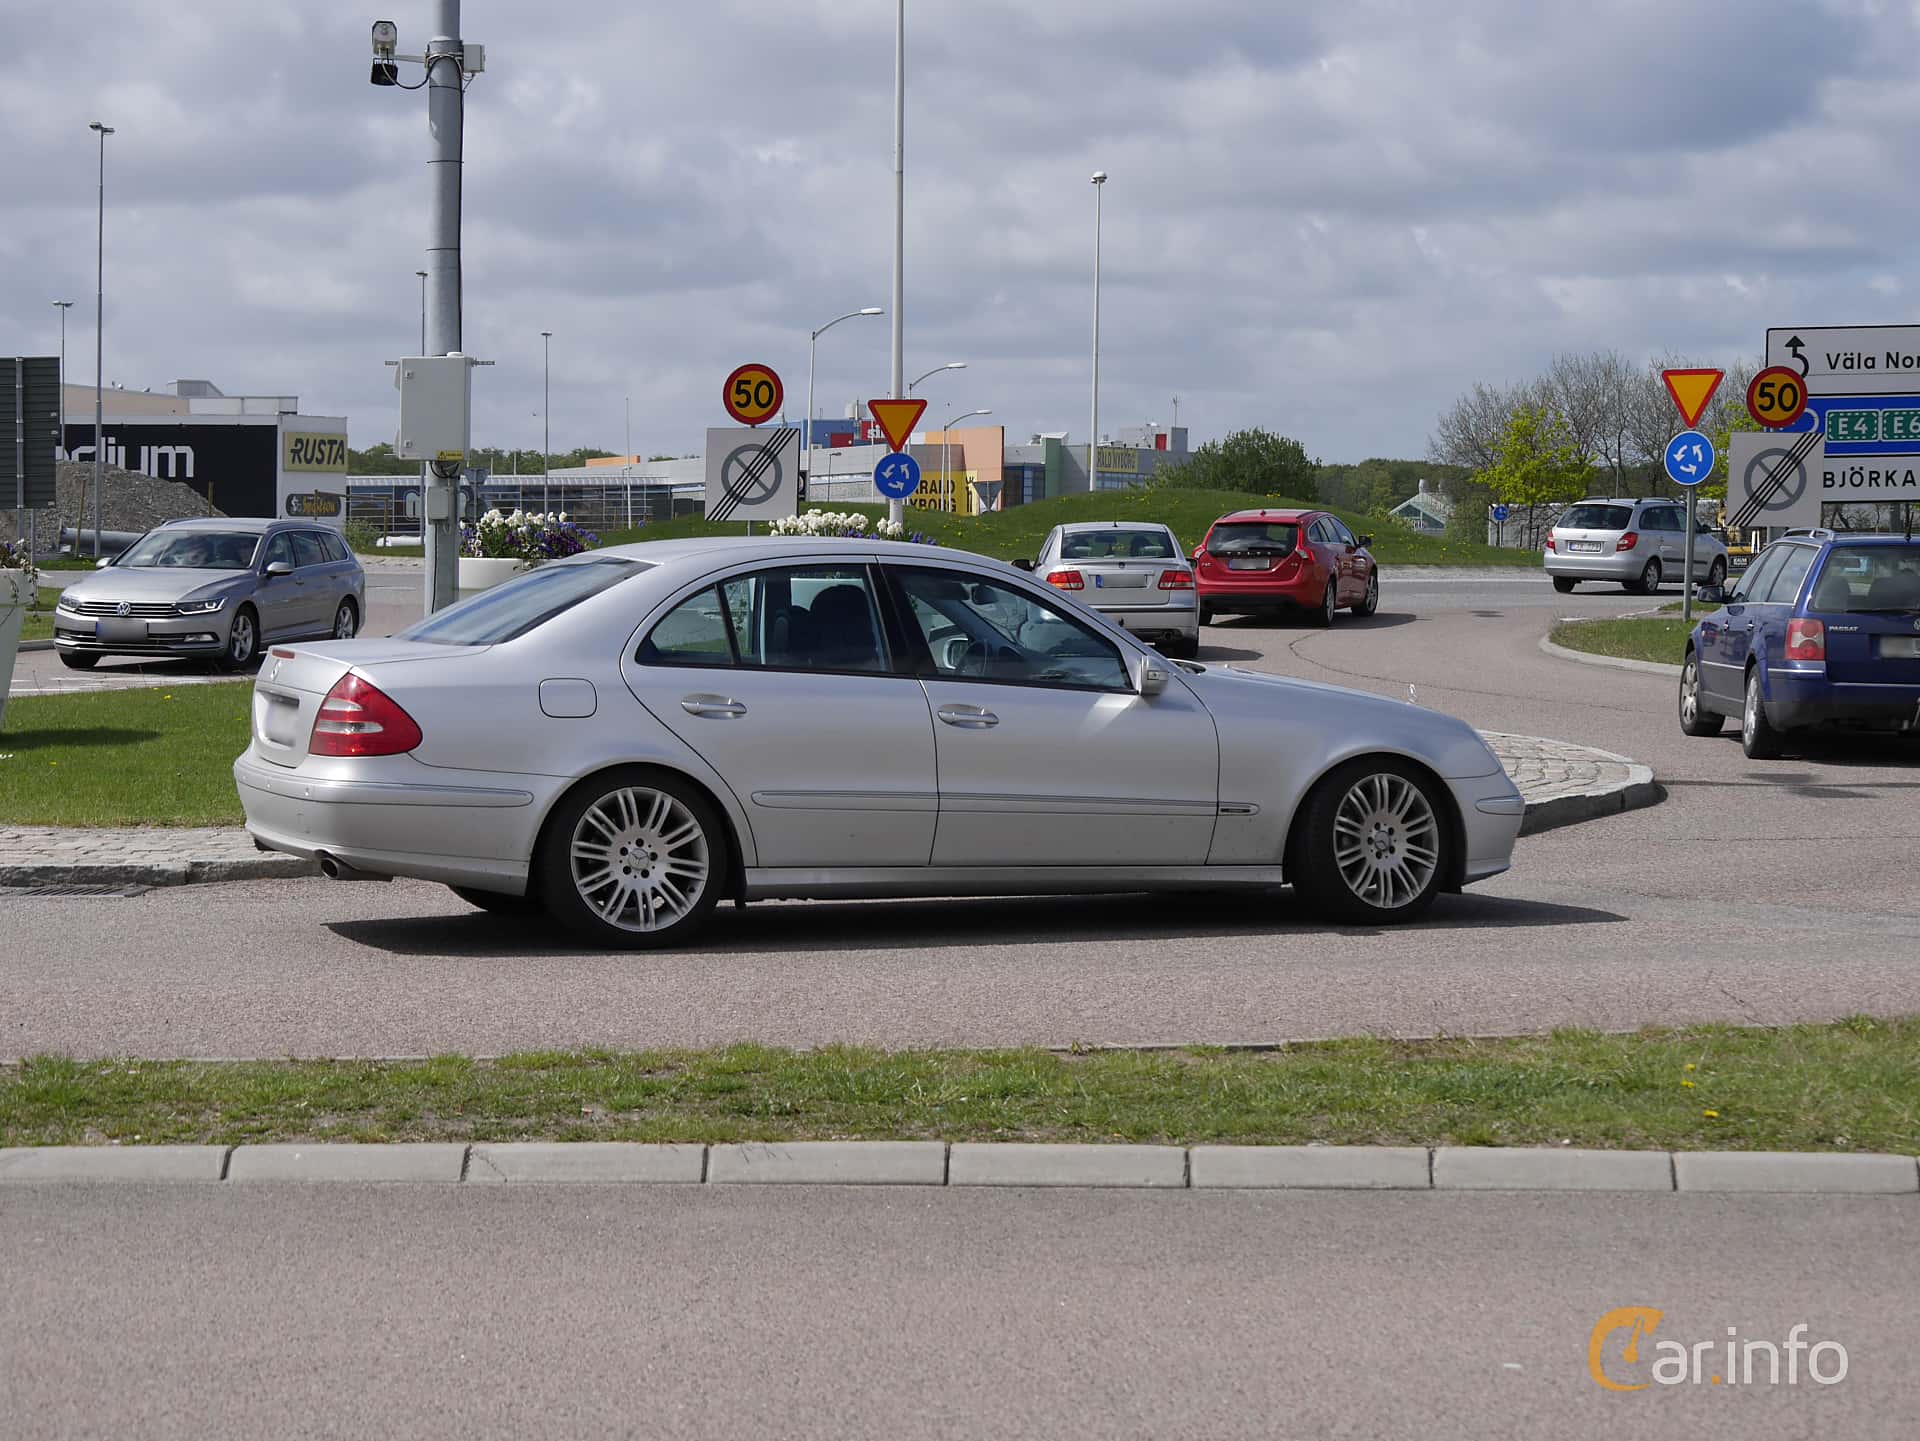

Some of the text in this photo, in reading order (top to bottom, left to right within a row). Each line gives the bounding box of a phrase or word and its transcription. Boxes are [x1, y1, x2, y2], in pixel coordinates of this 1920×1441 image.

[1826, 352, 1876, 369] Väla
[735, 380, 774, 409] 50
[1758, 382, 1798, 412] 50
[290, 438, 345, 465] RUSTA
[915, 480, 956, 494] RALD
[1823, 466, 1916, 488] BJÖRKA
